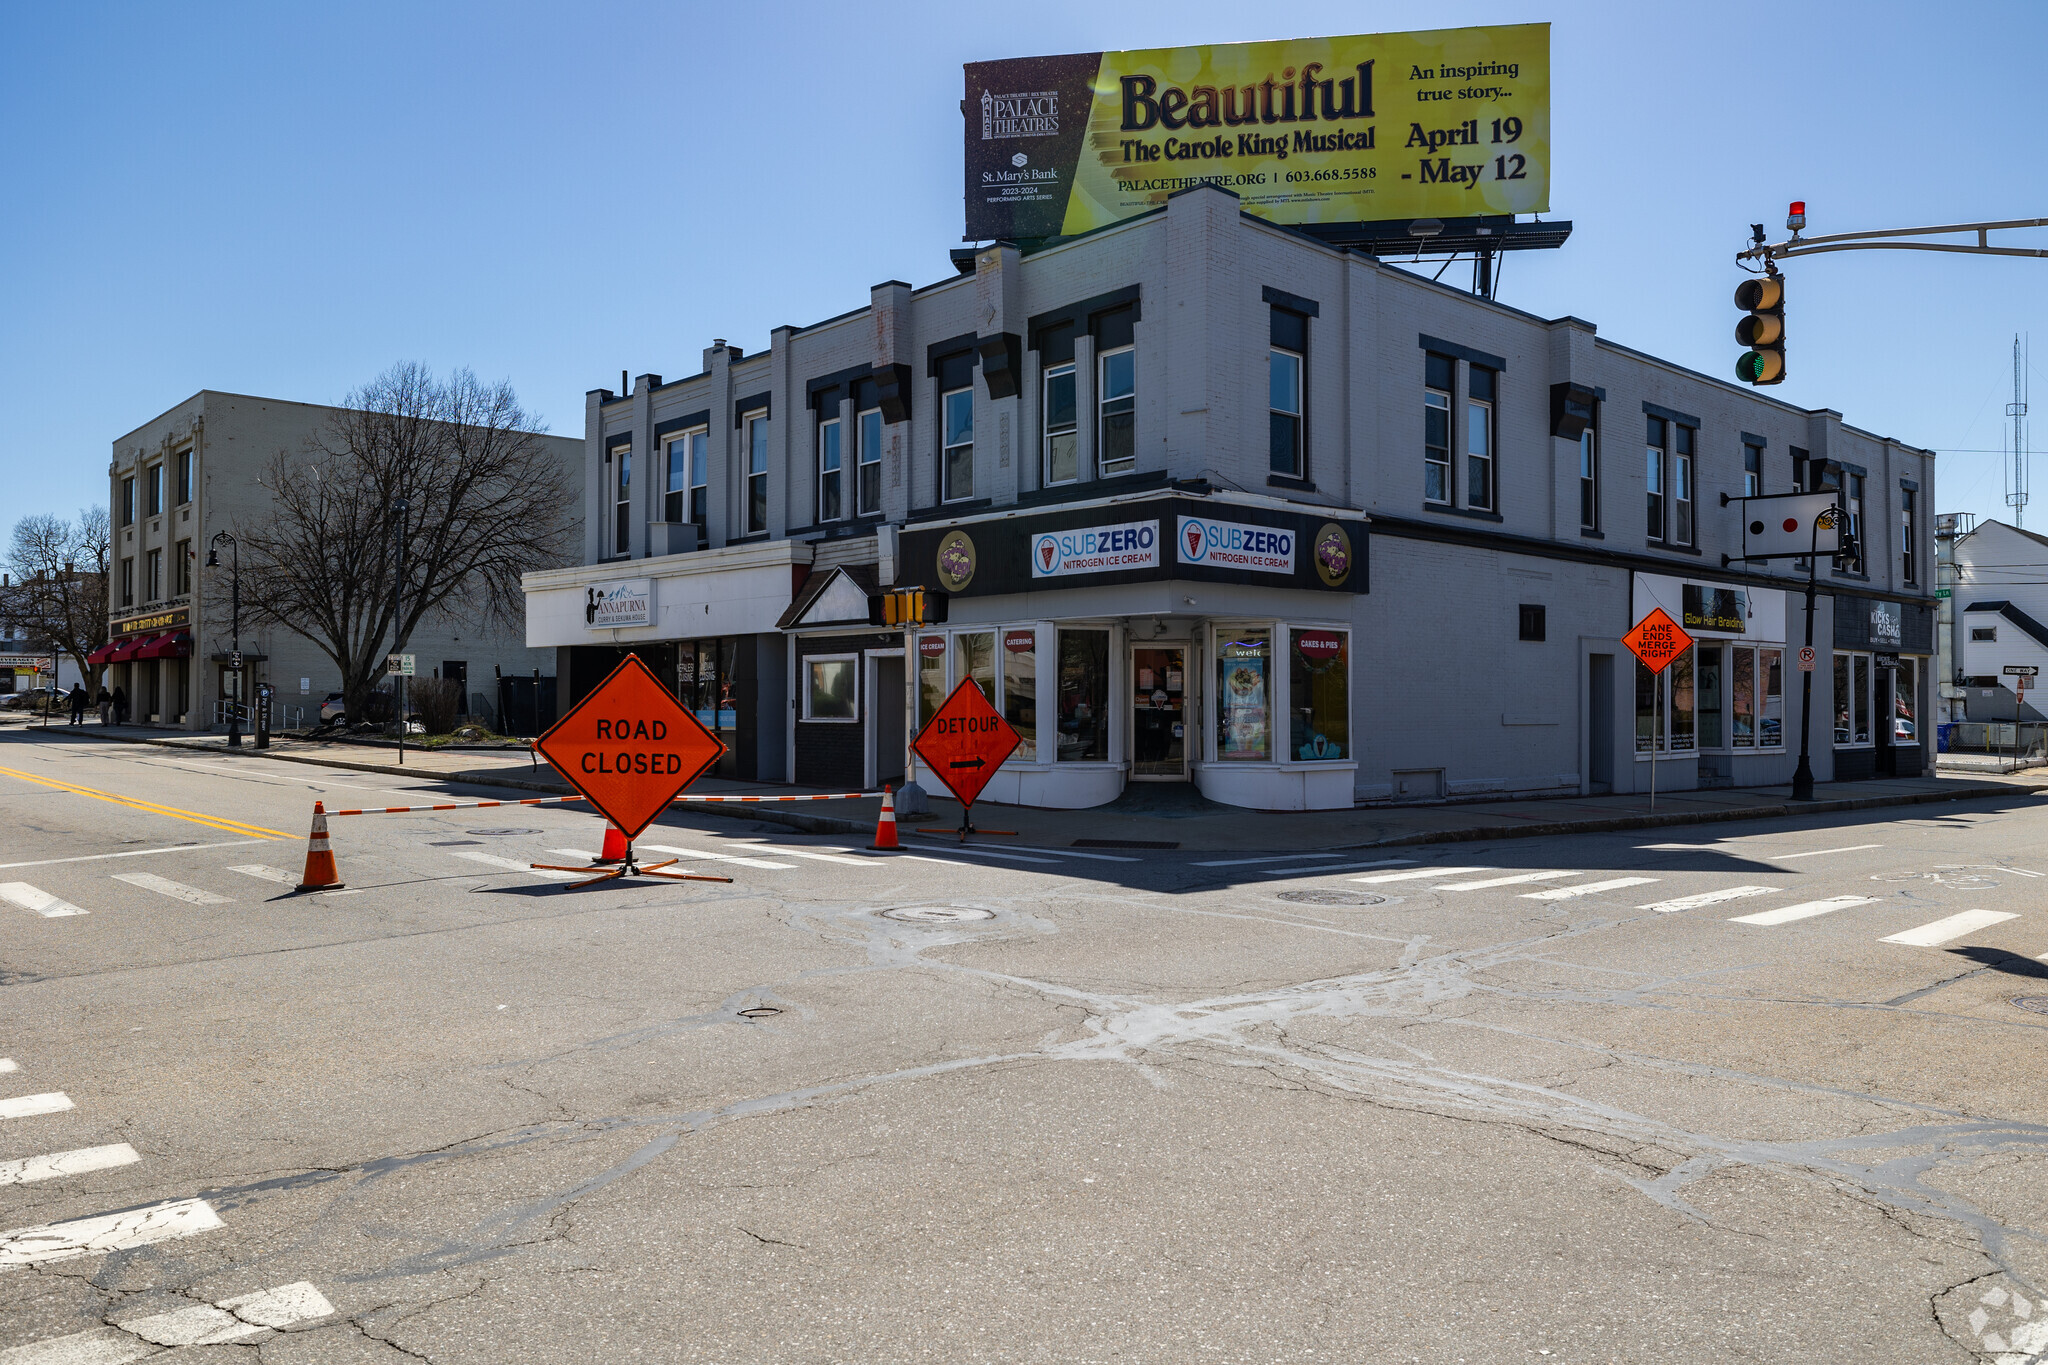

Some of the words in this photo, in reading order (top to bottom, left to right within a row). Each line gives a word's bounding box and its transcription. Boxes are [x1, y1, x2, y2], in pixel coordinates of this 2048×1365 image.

[1408, 64, 1435, 80] An
[1439, 60, 1519, 81] inspiring
[1119, 58, 1375, 132] Beautiful
[1416, 88, 1453, 102] true
[1457, 85, 1512, 102] story...
[995, 97, 1059, 118] PALACE
[993, 116, 1059, 133] THEATRES
[1120, 137, 1161, 163] The
[1163, 133, 1234, 161] Carole
[1236, 131, 1289, 160] King
[1292, 125, 1376, 153] Musical
[1404, 119, 1479, 155] April
[1490, 116, 1523, 144] 19
[982, 171, 995, 183] St.
[997, 169, 1029, 183] Mary's
[1031, 168, 1058, 180] Bank
[1118, 172, 1267, 192] PALACETHEATRE.ORG
[1285, 166, 1377, 184] 603.668.5588
[1419, 158, 1485, 190] May
[1494, 153, 1527, 181] 12
[1001, 186, 1039, 196] 2023-2024
[1061, 526, 1154, 557] SUBZERO
[1208, 525, 1291, 556] SUBZERO
[1063, 557, 1104, 570] NITROGEN
[1106, 555, 1120, 565] ICE
[1121, 552, 1152, 564] CREAM
[1209, 551, 1249, 565] NITROGEN
[1250, 556, 1263, 566] ICE
[1264, 557, 1289, 569] CREAM
[598, 600, 646, 615] ANNAPURNA
[632, 613, 646, 621] HOUSE
[1684, 612, 1702, 625] Glow
[1703, 614, 1717, 626] Hair
[1718, 616, 1745, 631] Braiding
[1870, 611, 1890, 625] KICKS
[1642, 623, 1673, 632] LANE
[1642, 632, 1672, 641] ENDS
[1877, 623, 1896, 637] CASH
[1006, 638, 1033, 646] CATERING
[1301, 640, 1319, 648] CAKES
[1325, 641, 1339, 649] PIES
[1638, 641, 1676, 650] MERGE
[1640, 649, 1674, 658] RIGHT
[596, 718, 667, 741] ROAD
[937, 716, 999, 734] DETOUR
[581, 751, 682, 775] CLOSED
